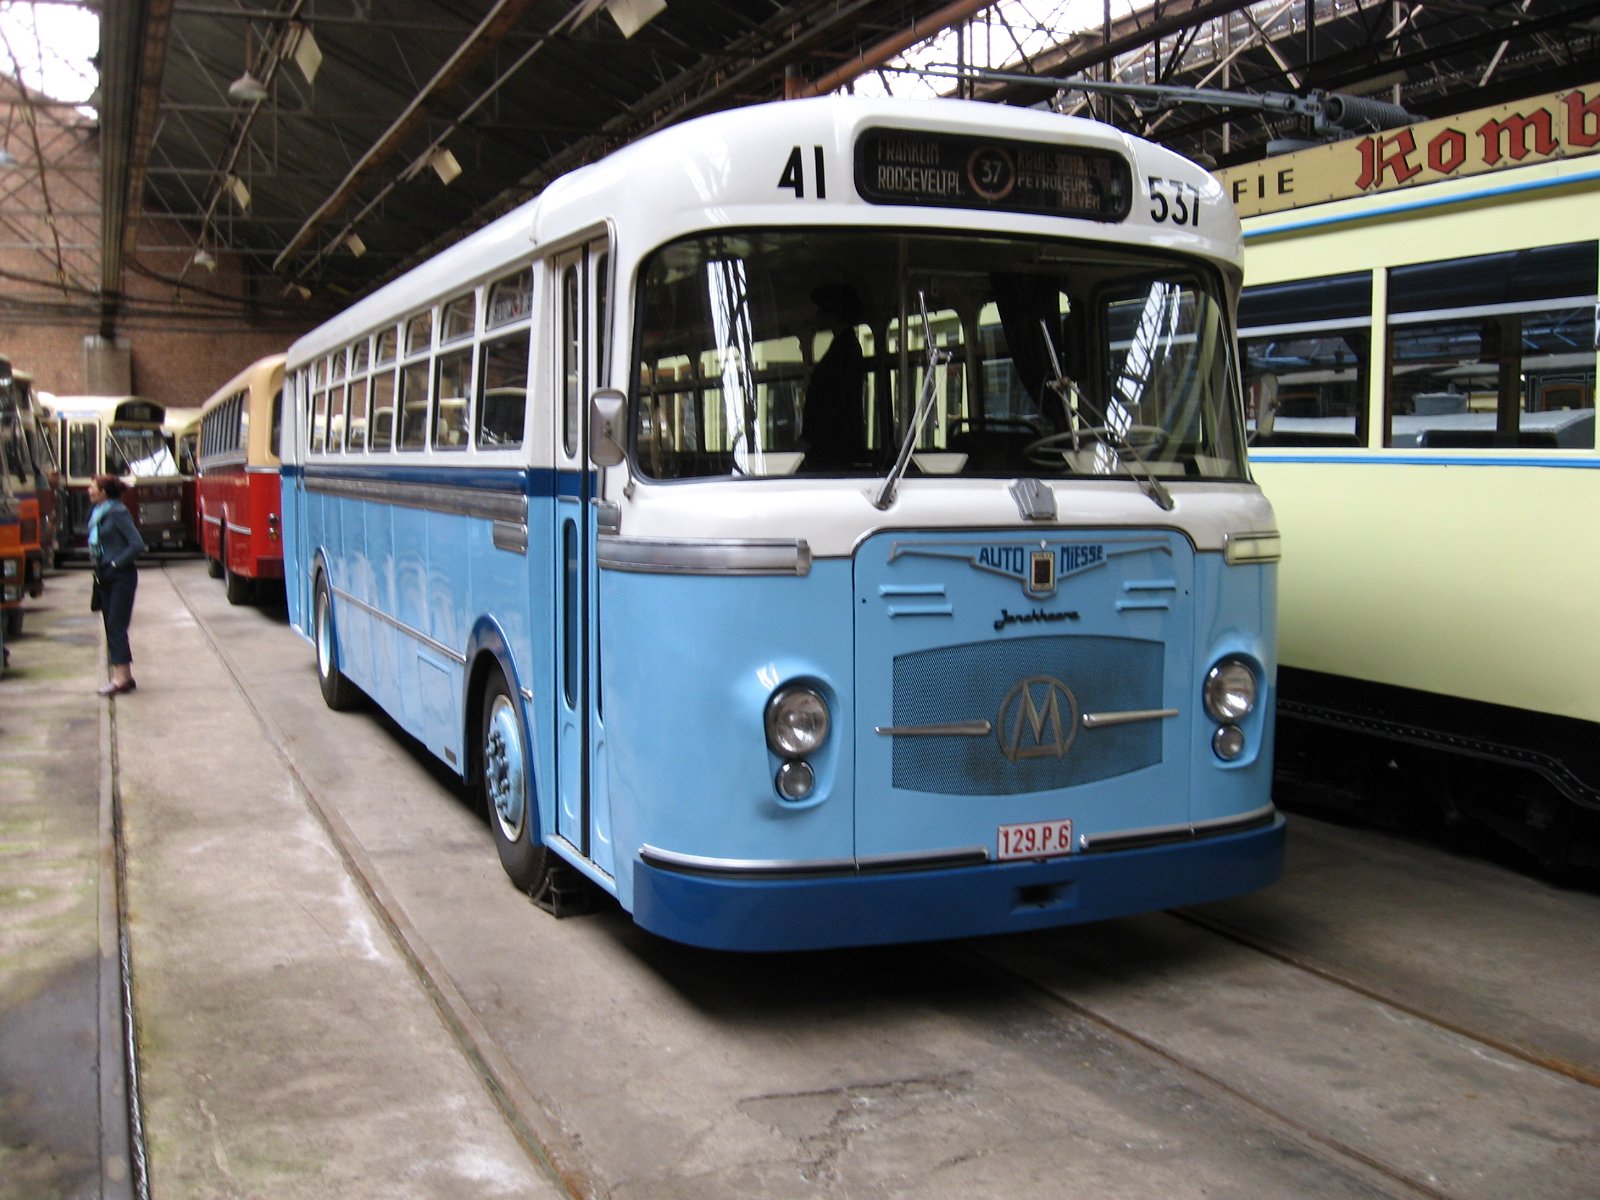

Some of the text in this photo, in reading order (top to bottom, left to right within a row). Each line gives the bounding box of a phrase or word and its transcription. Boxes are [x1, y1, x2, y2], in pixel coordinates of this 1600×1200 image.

[878, 137, 940, 165] FRANKLIN
[777, 145, 826, 199] 41
[981, 159, 1003, 184] 37
[1061, 191, 1101, 211] HAVEN
[1148, 176, 1199, 227] 537
[979, 545, 1104, 574] AUTO MIESSE
[1002, 825, 1069, 853] 129.P.6
